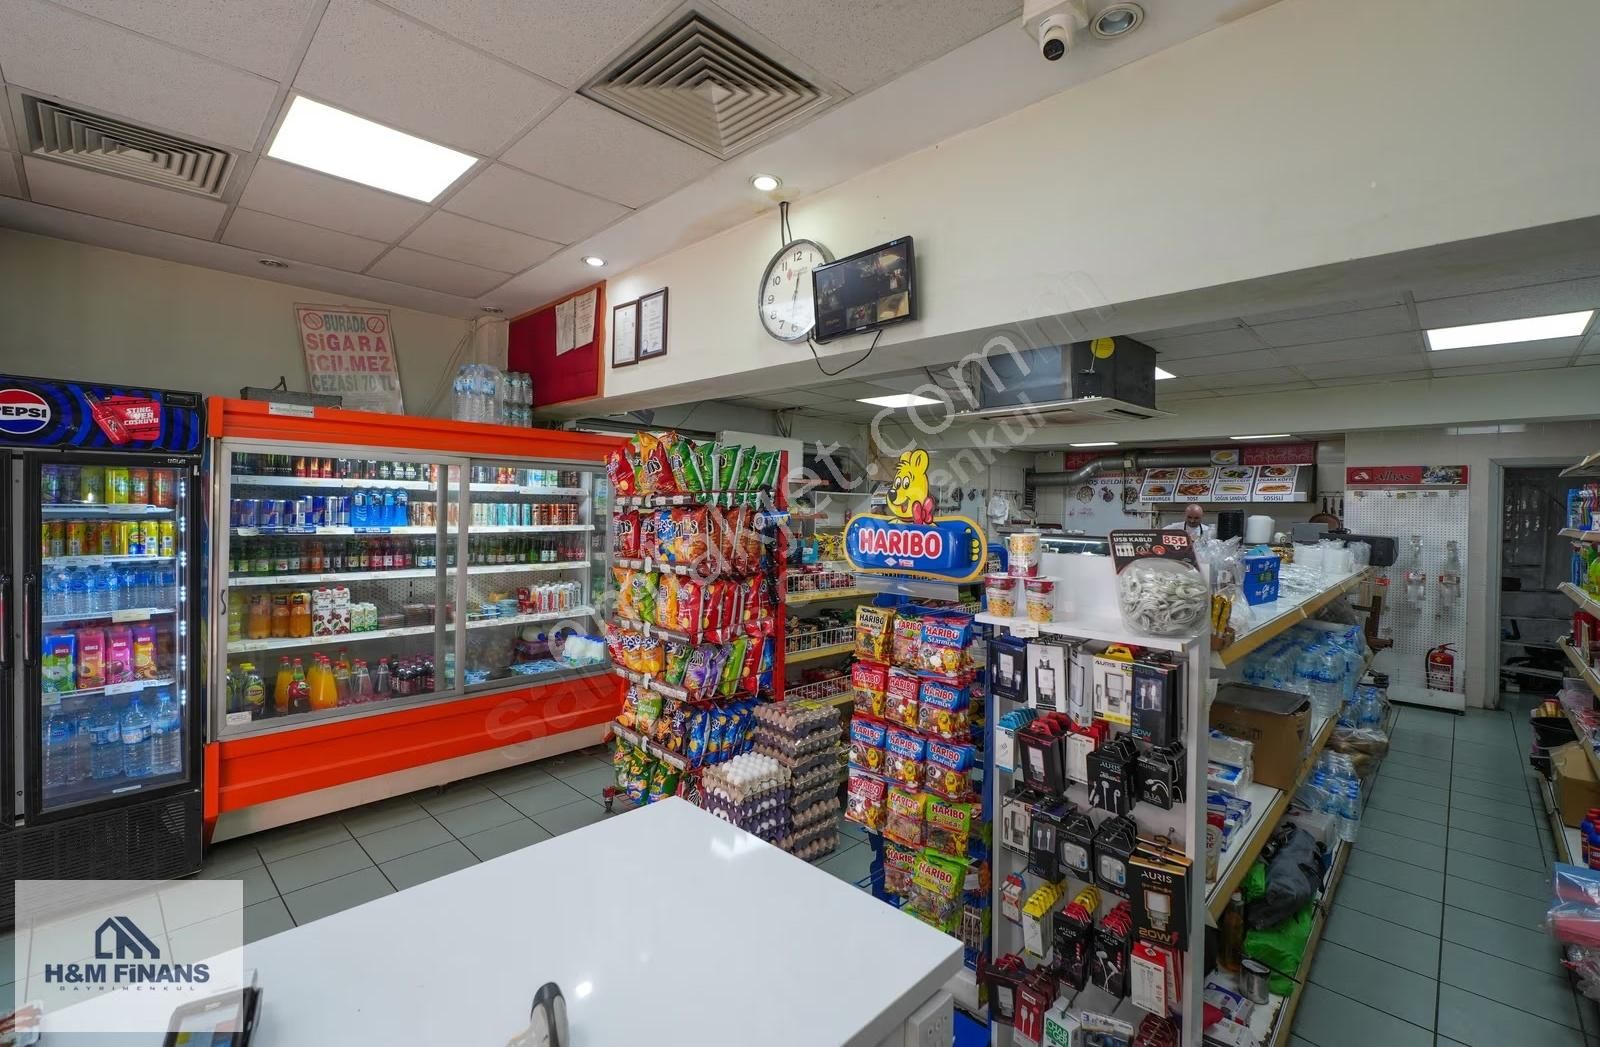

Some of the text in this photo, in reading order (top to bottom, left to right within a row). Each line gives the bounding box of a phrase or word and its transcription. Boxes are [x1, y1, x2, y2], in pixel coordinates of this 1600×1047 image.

[793, 251, 803, 262] 12
[781, 261, 788, 271] 11
[772, 276, 781, 287] 10
[767, 294, 775, 305] 9
[323, 314, 367, 333] BURADA
[779, 320, 786, 330] 7
[858, 528, 943, 559] HARIBO
[859, 613, 885, 625] HARIBO
[925, 626, 960, 641] HARIBO
[855, 670, 881, 684] HARIBO
[890, 677, 916, 692] HARIBO
[923, 685, 954, 701] HARIBO
[853, 724, 880, 740] HARIBO
[889, 734, 919, 751] HARIBO
[930, 744, 960, 762] HARIBO
[890, 792, 919, 810] HARIBO
[931, 803, 965, 820] HARIBO
[918, 863, 952, 884] HARIBO
[1141, 870, 1173, 884] AURIS
[1138, 926, 1171, 942] 20W
